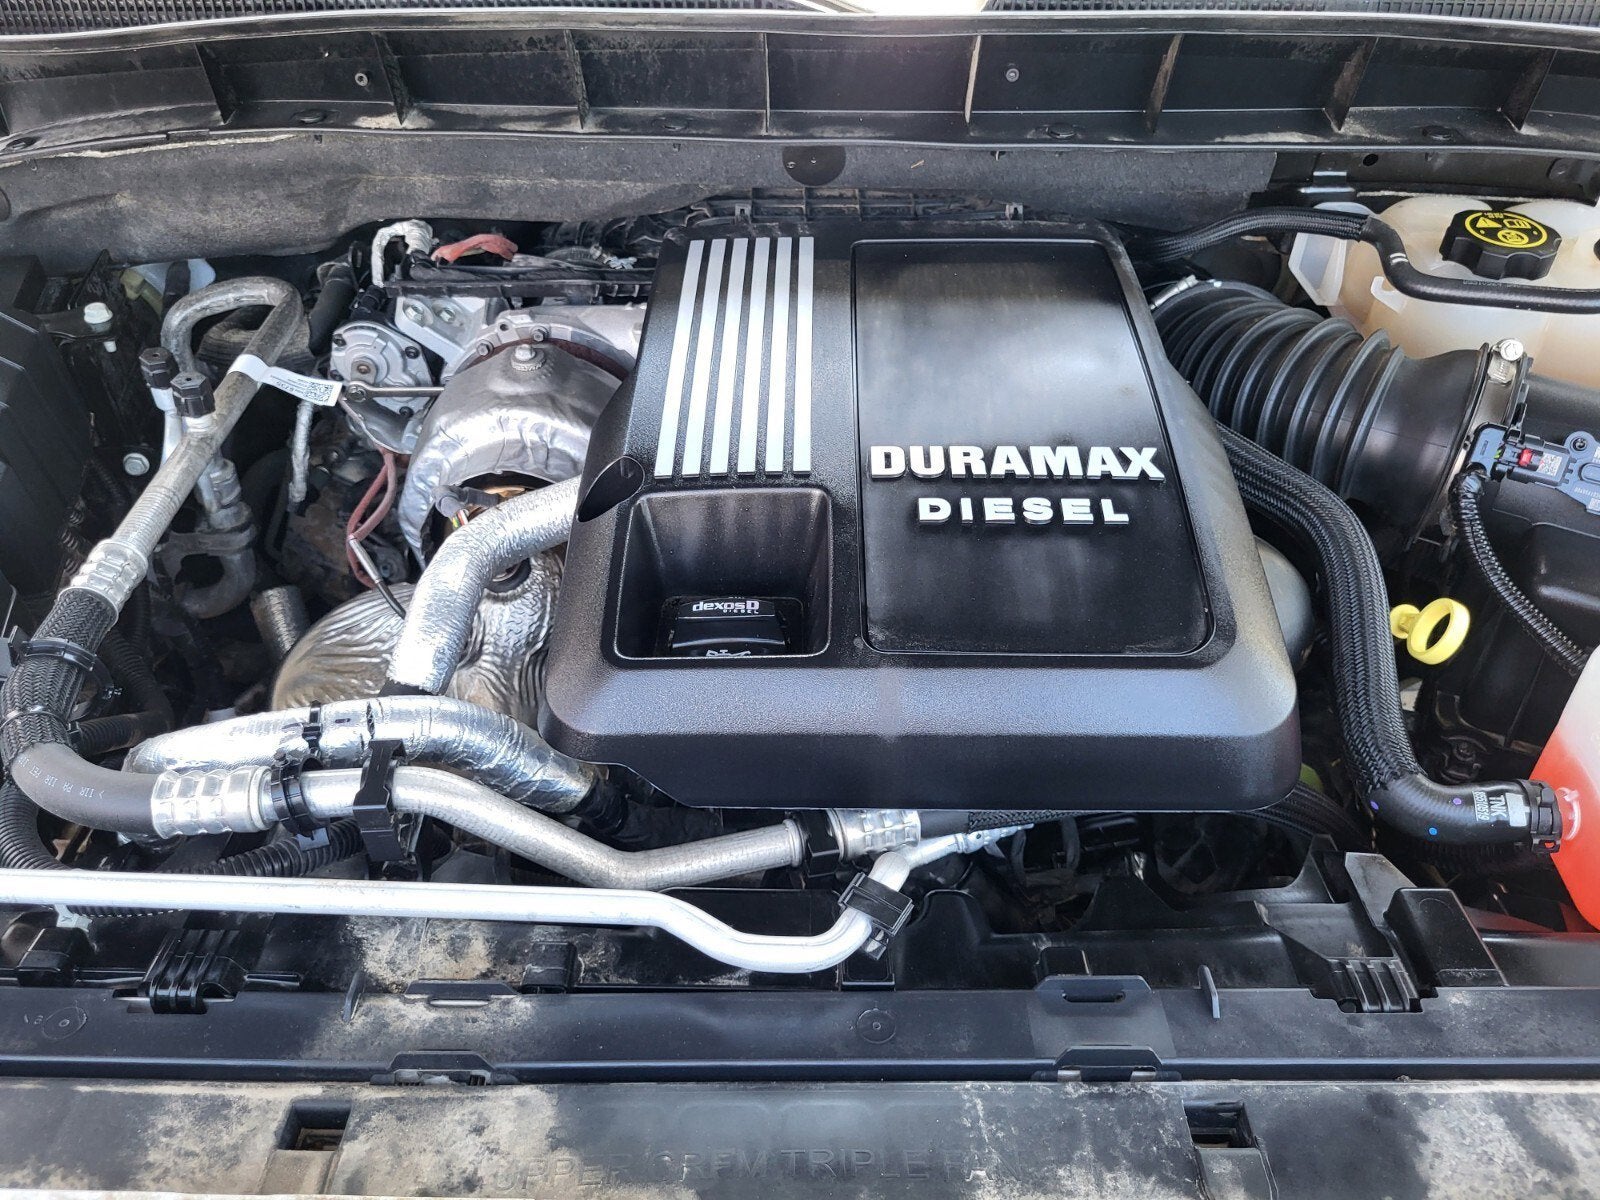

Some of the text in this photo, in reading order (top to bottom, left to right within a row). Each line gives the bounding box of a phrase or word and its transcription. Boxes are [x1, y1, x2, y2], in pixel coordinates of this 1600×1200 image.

[870, 445, 1166, 480] DURAMAX
[917, 497, 1130, 525] DIESEL
[1489, 794, 1507, 818] TNK
[491, 1153, 634, 1191] UPPER
[780, 1148, 930, 1182] TRIPLE
[942, 1148, 1022, 1182] FAN
